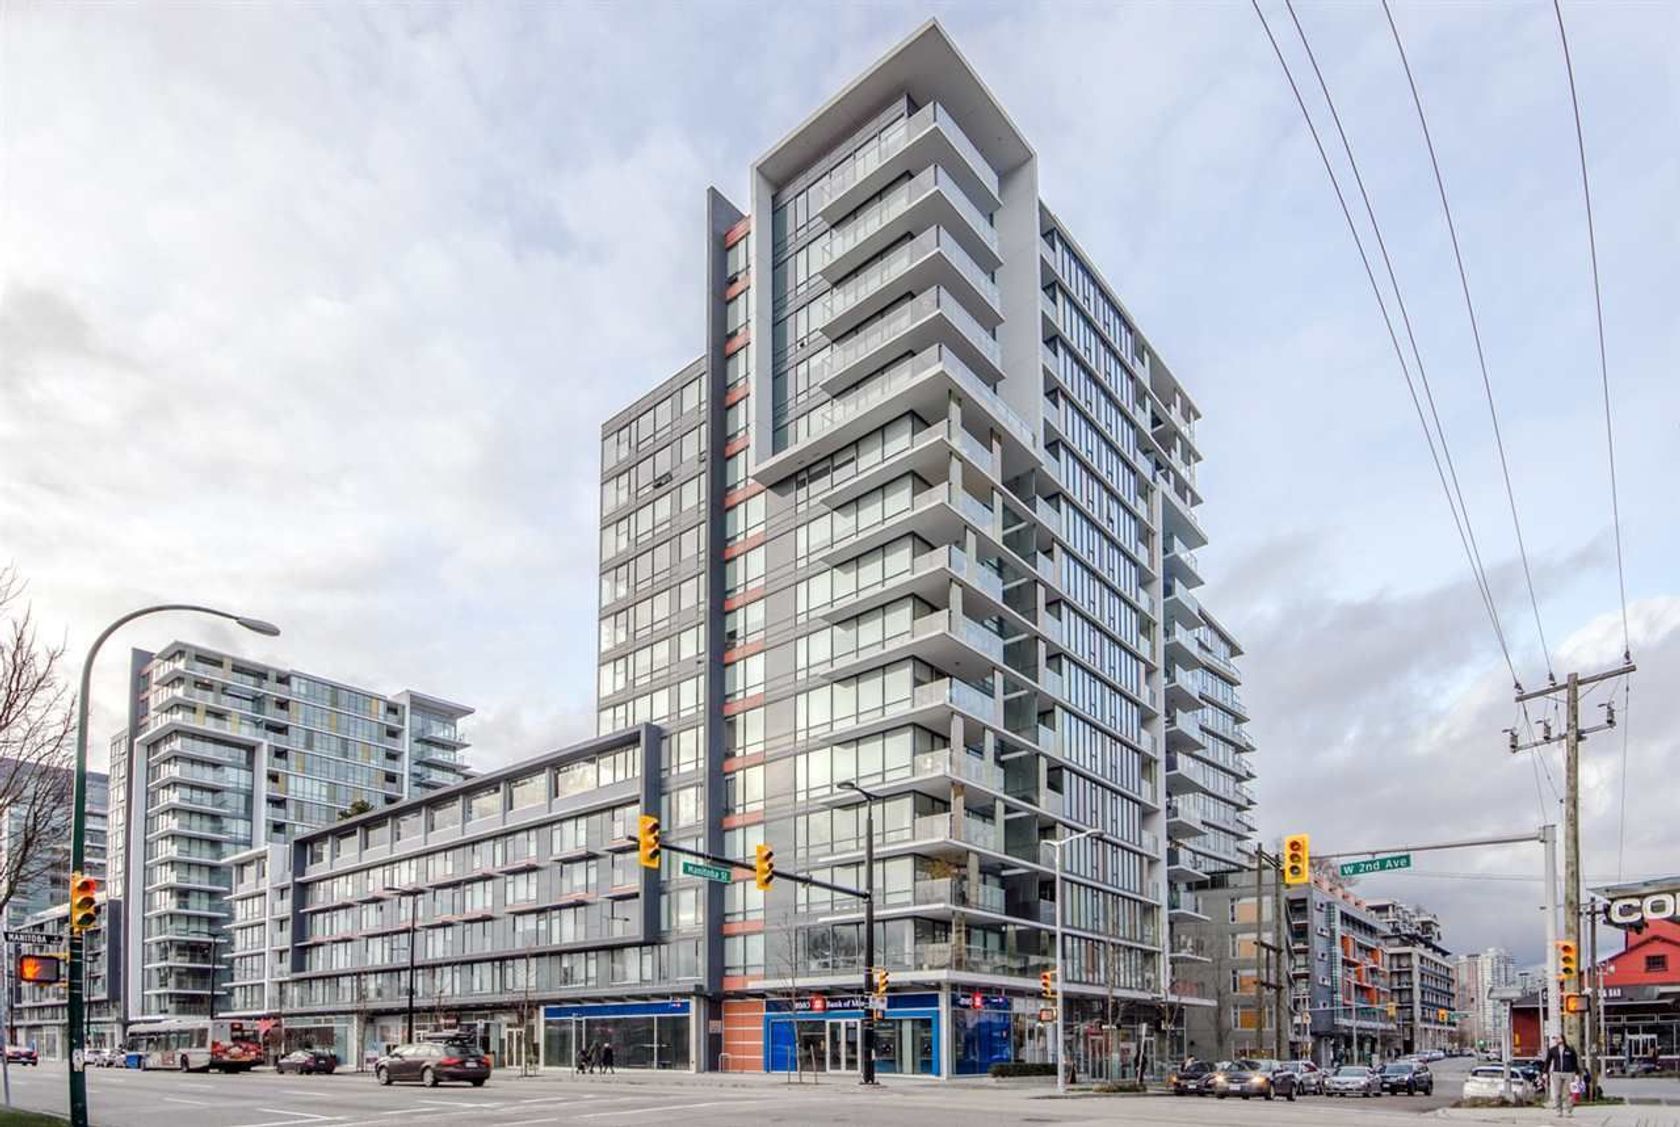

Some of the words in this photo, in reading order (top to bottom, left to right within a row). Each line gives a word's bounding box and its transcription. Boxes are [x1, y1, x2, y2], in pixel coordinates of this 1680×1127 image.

[687, 865, 719, 878] Manitoba
[1343, 865, 1354, 874] W
[1359, 861, 1380, 872] 2nd
[1385, 858, 1407, 868] Ave
[1610, 893, 1680, 923] CO
[8, 933, 47, 943] MANITOBA
[827, 1000, 842, 1008] Bank
